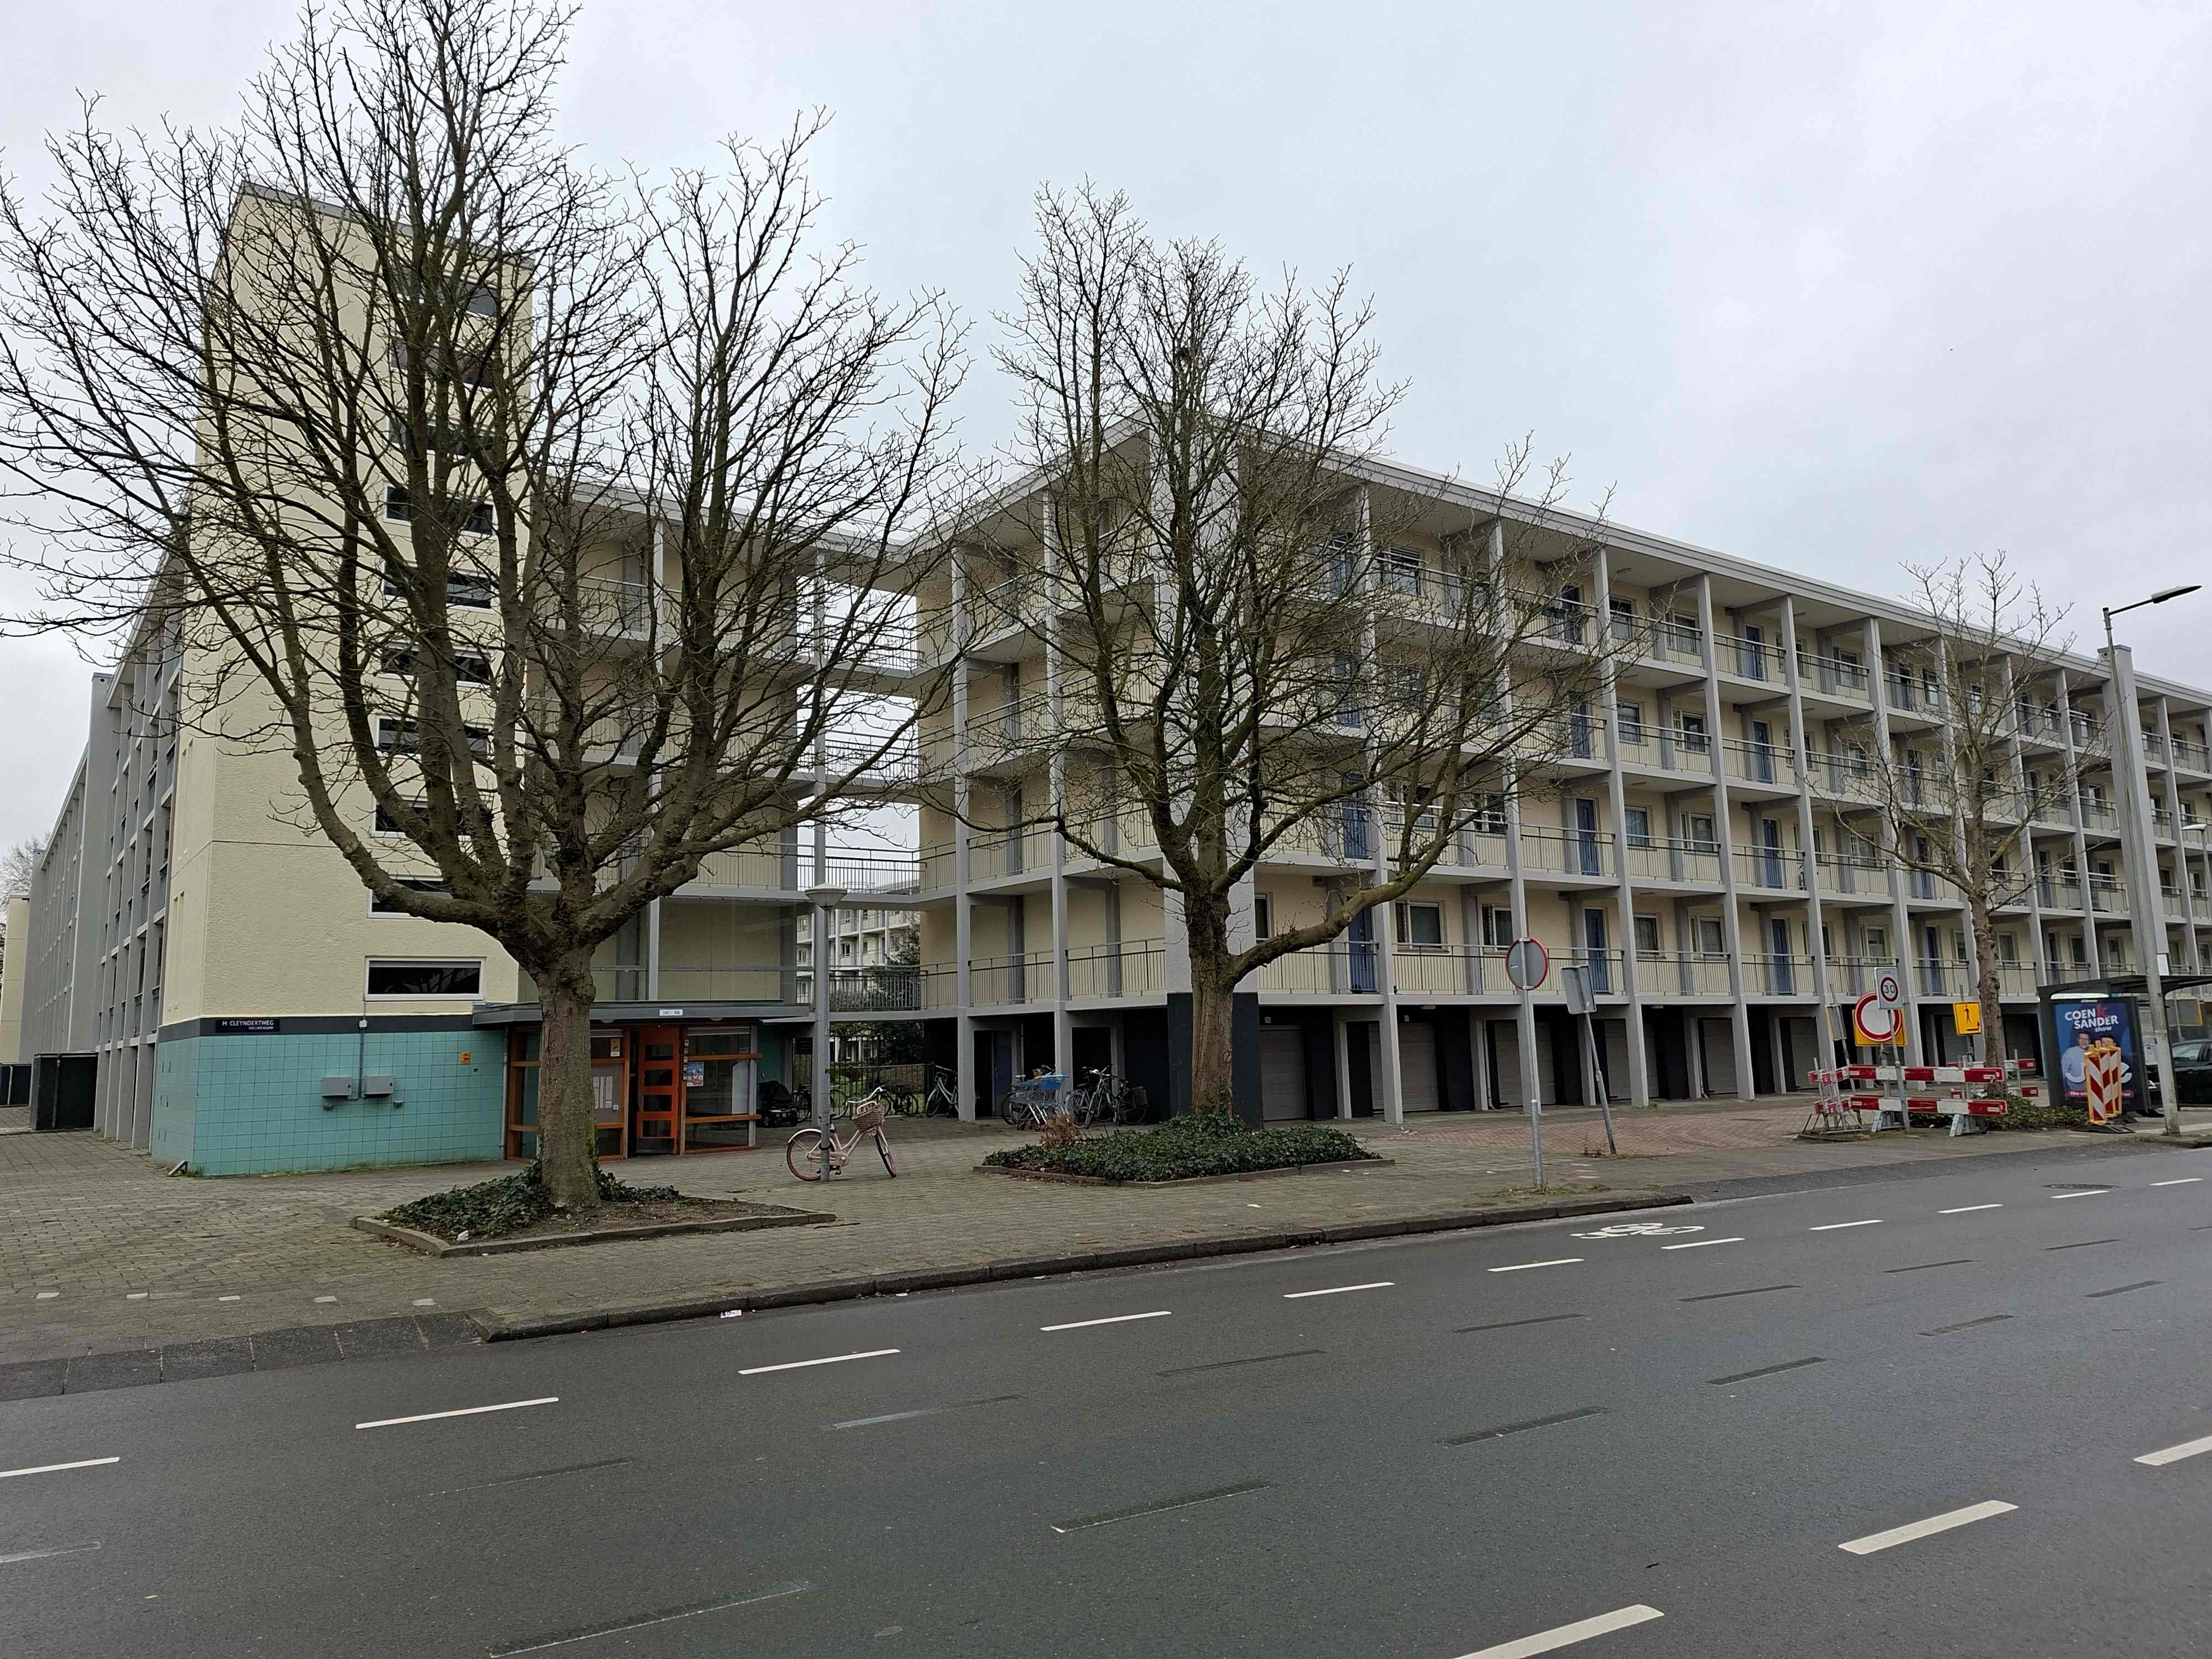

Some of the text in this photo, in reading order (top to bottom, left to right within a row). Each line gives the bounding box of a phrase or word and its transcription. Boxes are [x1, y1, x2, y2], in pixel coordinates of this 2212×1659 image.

[1884, 984, 1895, 994] 30
[2065, 1008, 2096, 1021] COEN
[2074, 1015, 2119, 1029] SANDER
